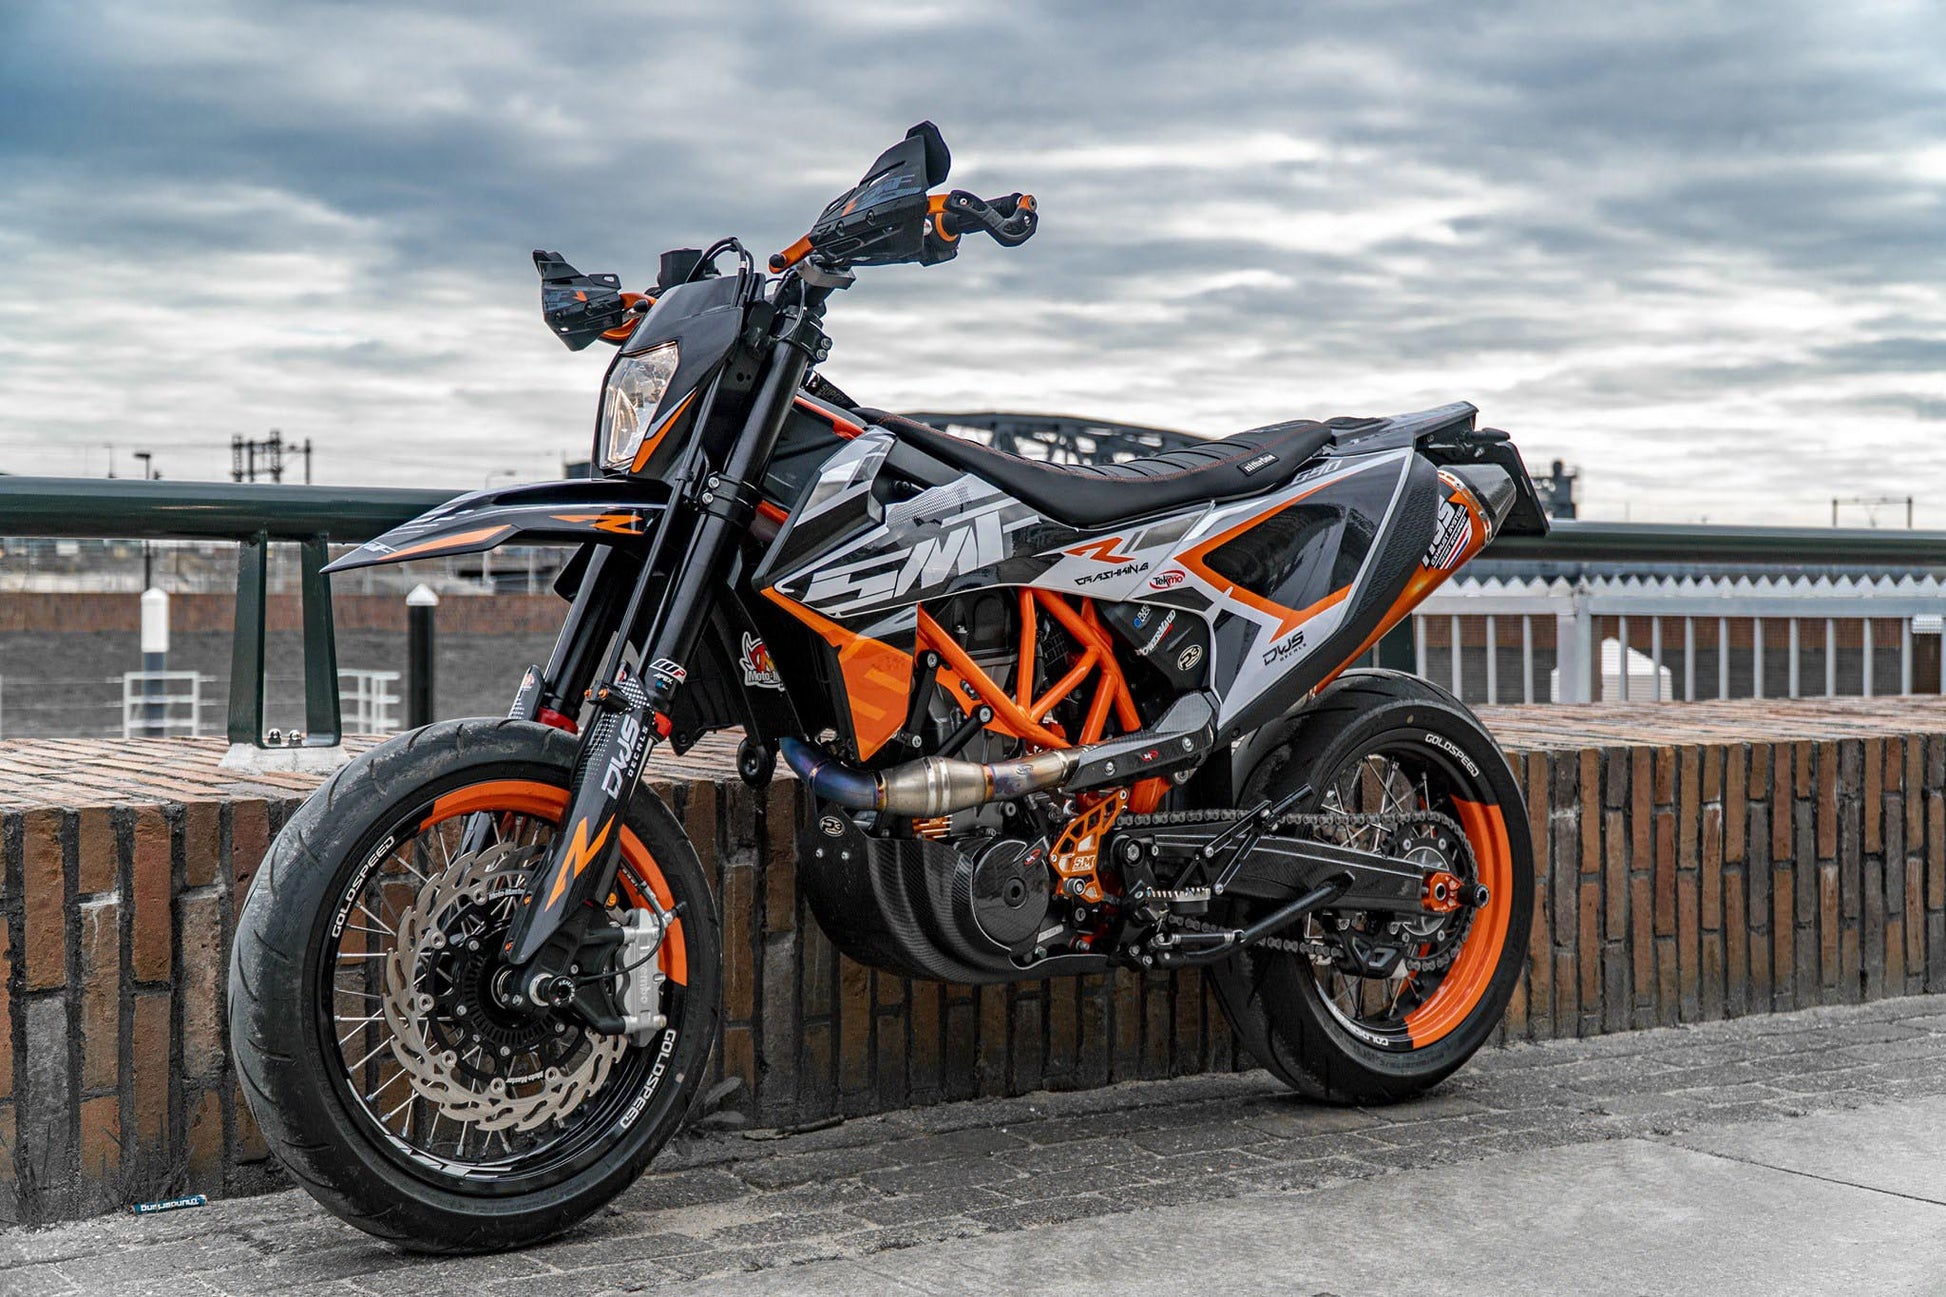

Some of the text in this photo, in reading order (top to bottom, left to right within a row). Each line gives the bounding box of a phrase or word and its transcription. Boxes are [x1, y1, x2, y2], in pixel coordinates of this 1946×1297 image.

[1290, 460, 1342, 486] 690
[1447, 505, 1465, 534] SYSTEM
[601, 714, 640, 800] DWS
[1425, 733, 1479, 777] GOLDSPEED
[331, 836, 395, 938] GOLDSPEED
[639, 963, 651, 1004] embo
[620, 1029, 676, 1129] GOLDSPEED
